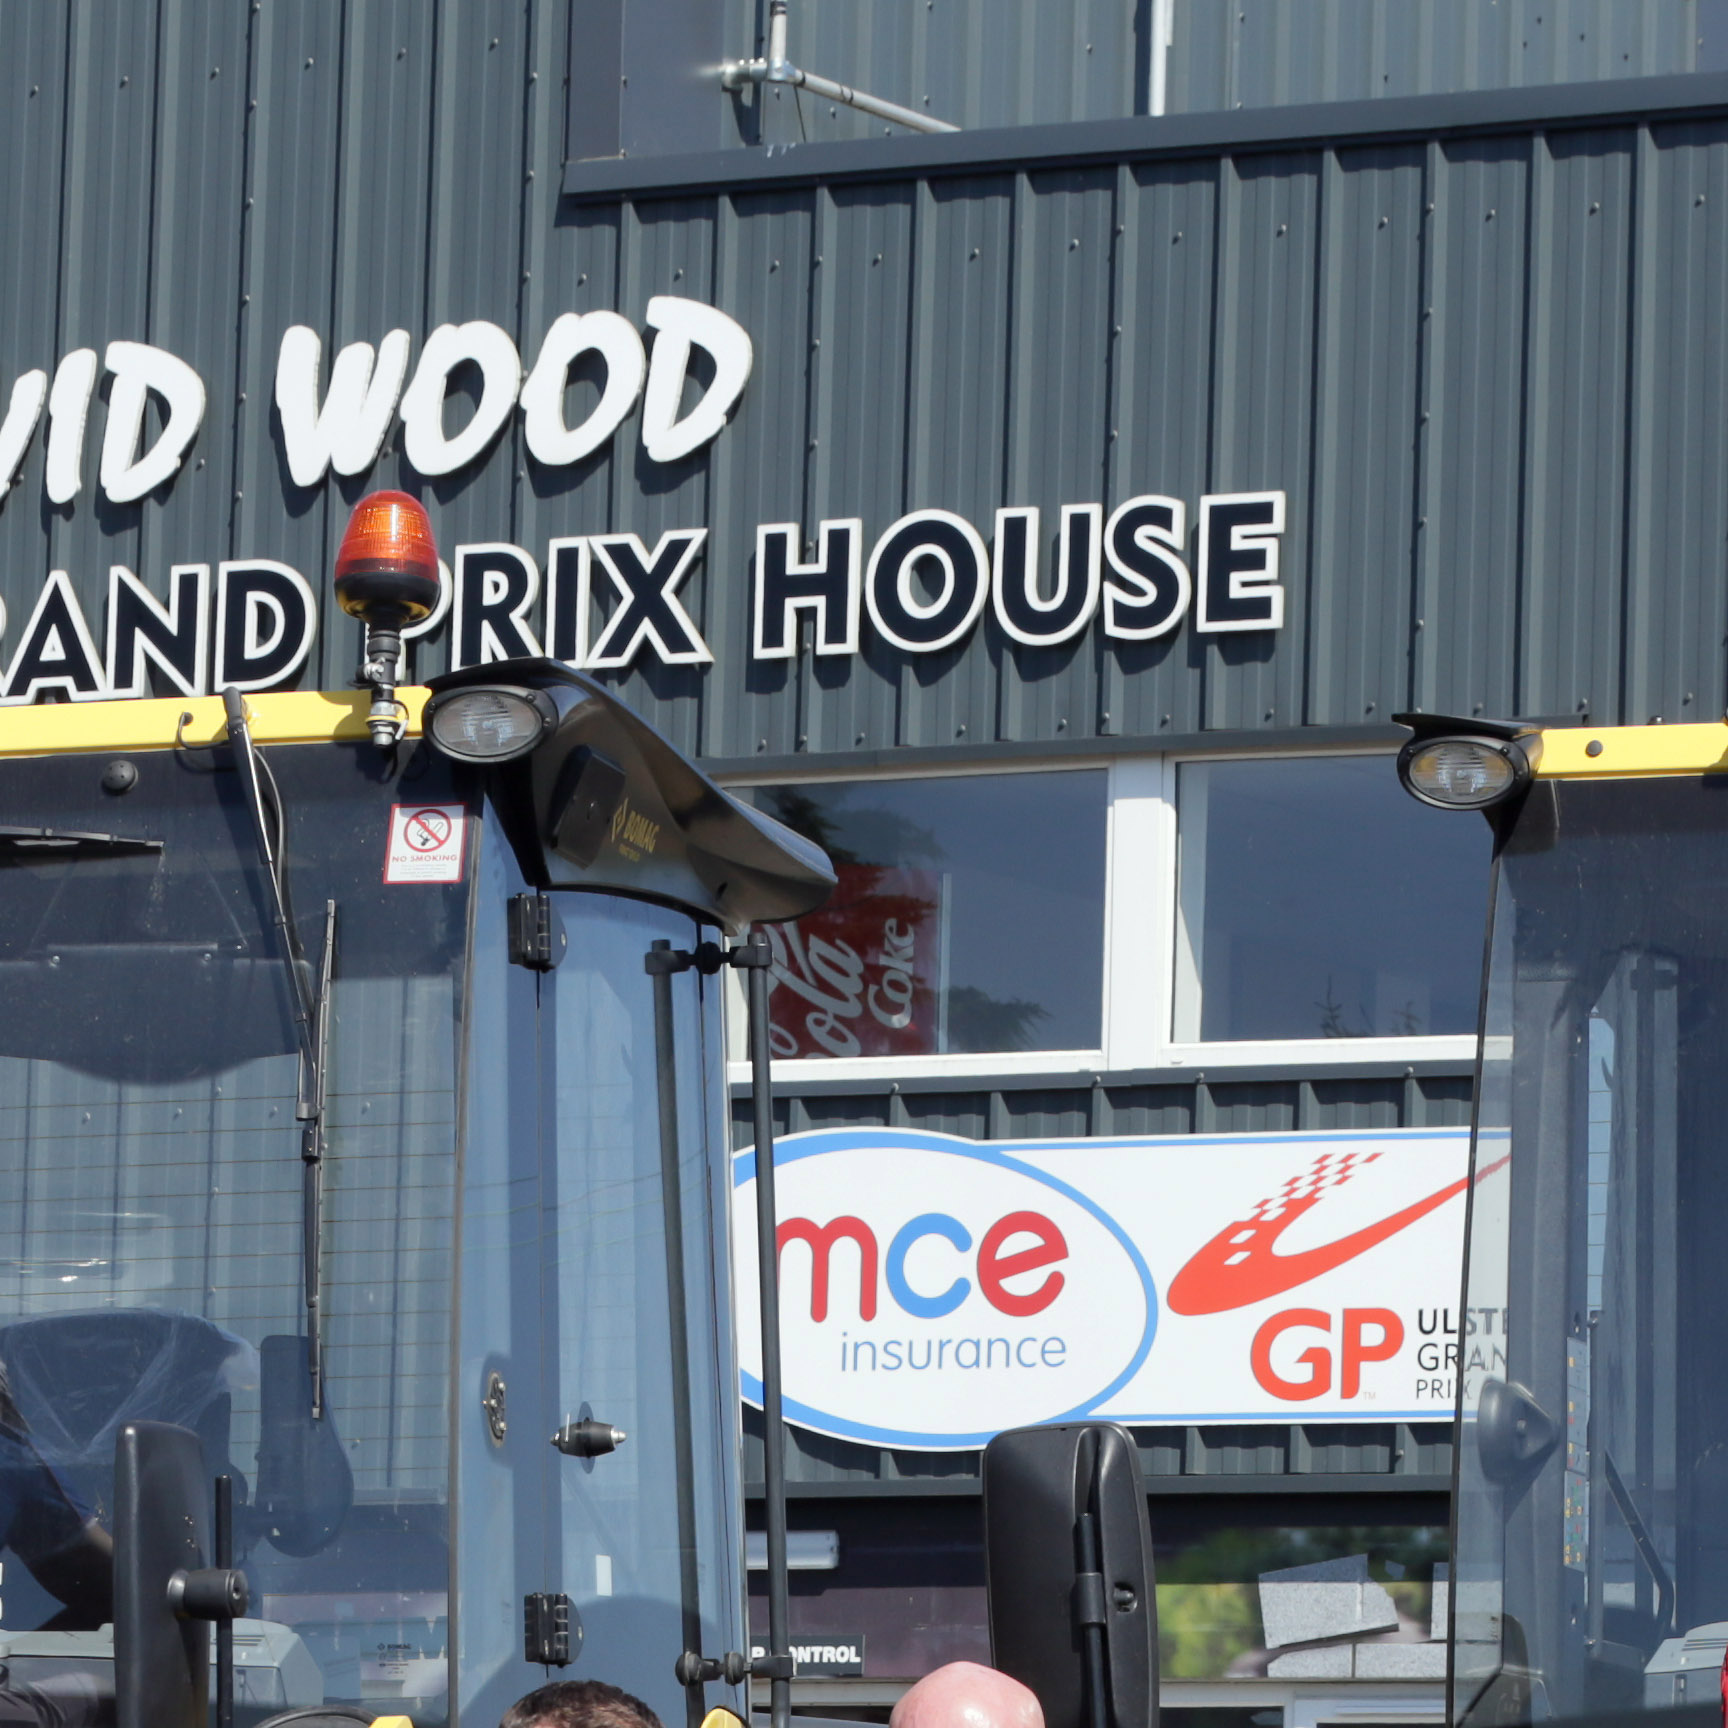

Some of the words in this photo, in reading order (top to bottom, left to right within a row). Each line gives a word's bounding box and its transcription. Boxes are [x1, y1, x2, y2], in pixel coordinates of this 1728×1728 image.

[275, 296, 752, 488] WOOD
[753, 490, 1286, 660] HOUSE
[868, 918, 915, 1029] Coke
[777, 1210, 1070, 1323] mce
[840, 1330, 1068, 1372] insurance
[1250, 1307, 1405, 1402] GP
